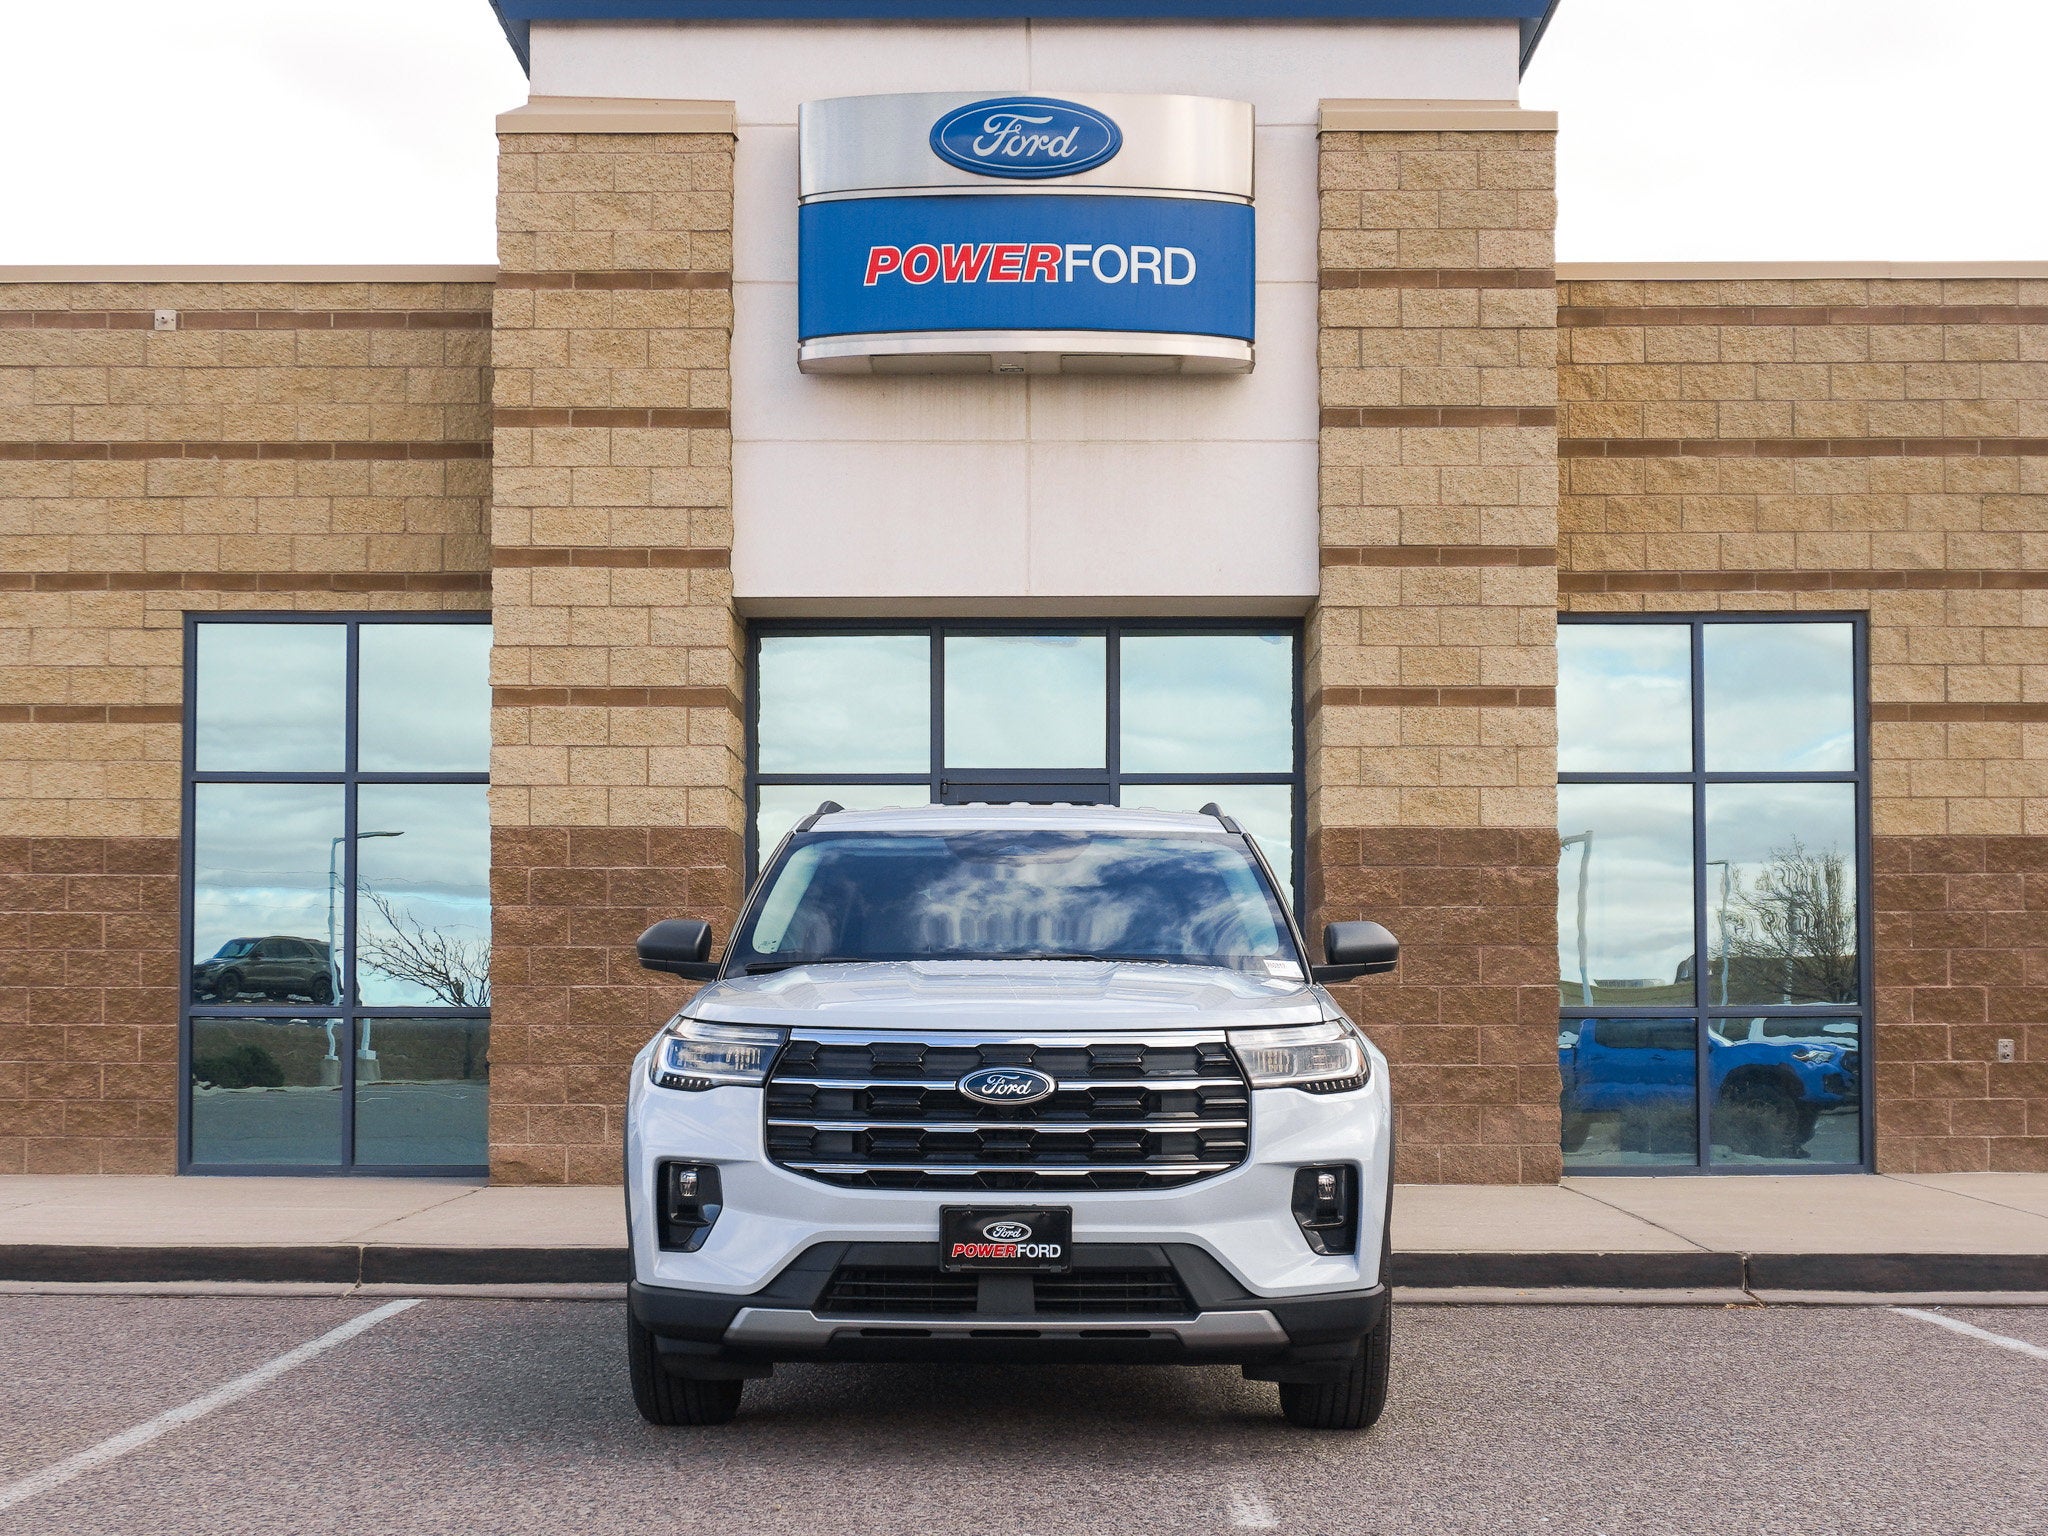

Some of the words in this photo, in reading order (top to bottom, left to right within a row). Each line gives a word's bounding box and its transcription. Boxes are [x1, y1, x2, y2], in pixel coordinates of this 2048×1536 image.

[973, 113, 1080, 158] Ford
[981, 1074, 1033, 1096] Ford
[992, 1225, 1022, 1239] Ford
